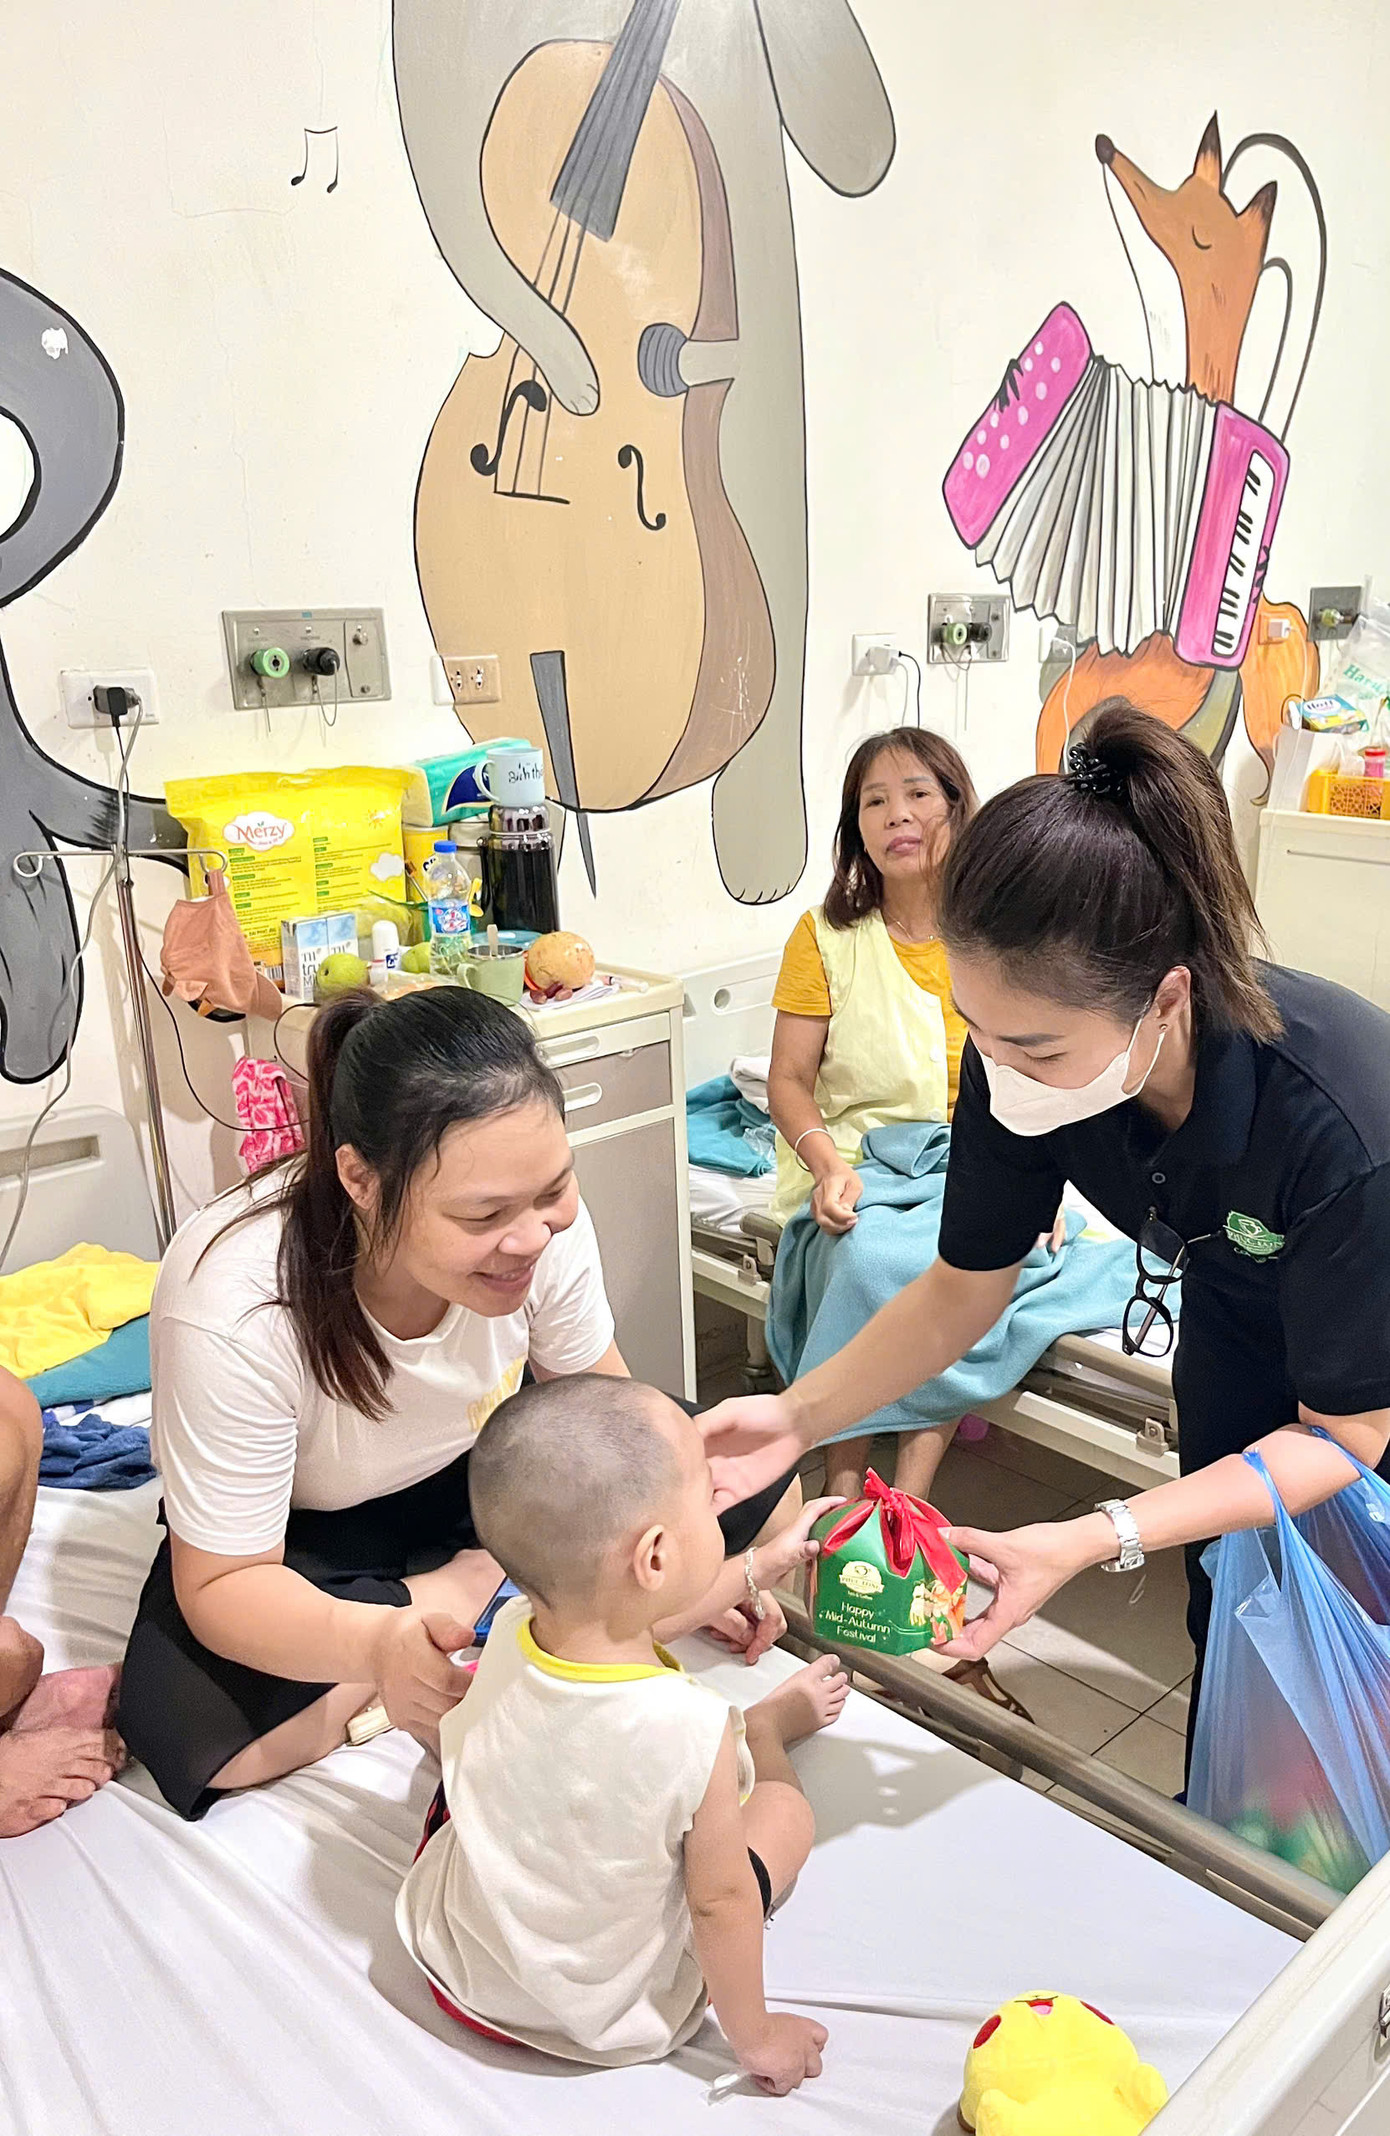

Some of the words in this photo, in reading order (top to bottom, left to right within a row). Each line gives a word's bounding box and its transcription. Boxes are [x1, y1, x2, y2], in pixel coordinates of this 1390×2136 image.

[230, 823, 286, 844] Merzy
[841, 1602, 875, 1620] Happy
[825, 1610, 890, 1634] Mid-Autumn
[837, 1625, 876, 1643] Festival
